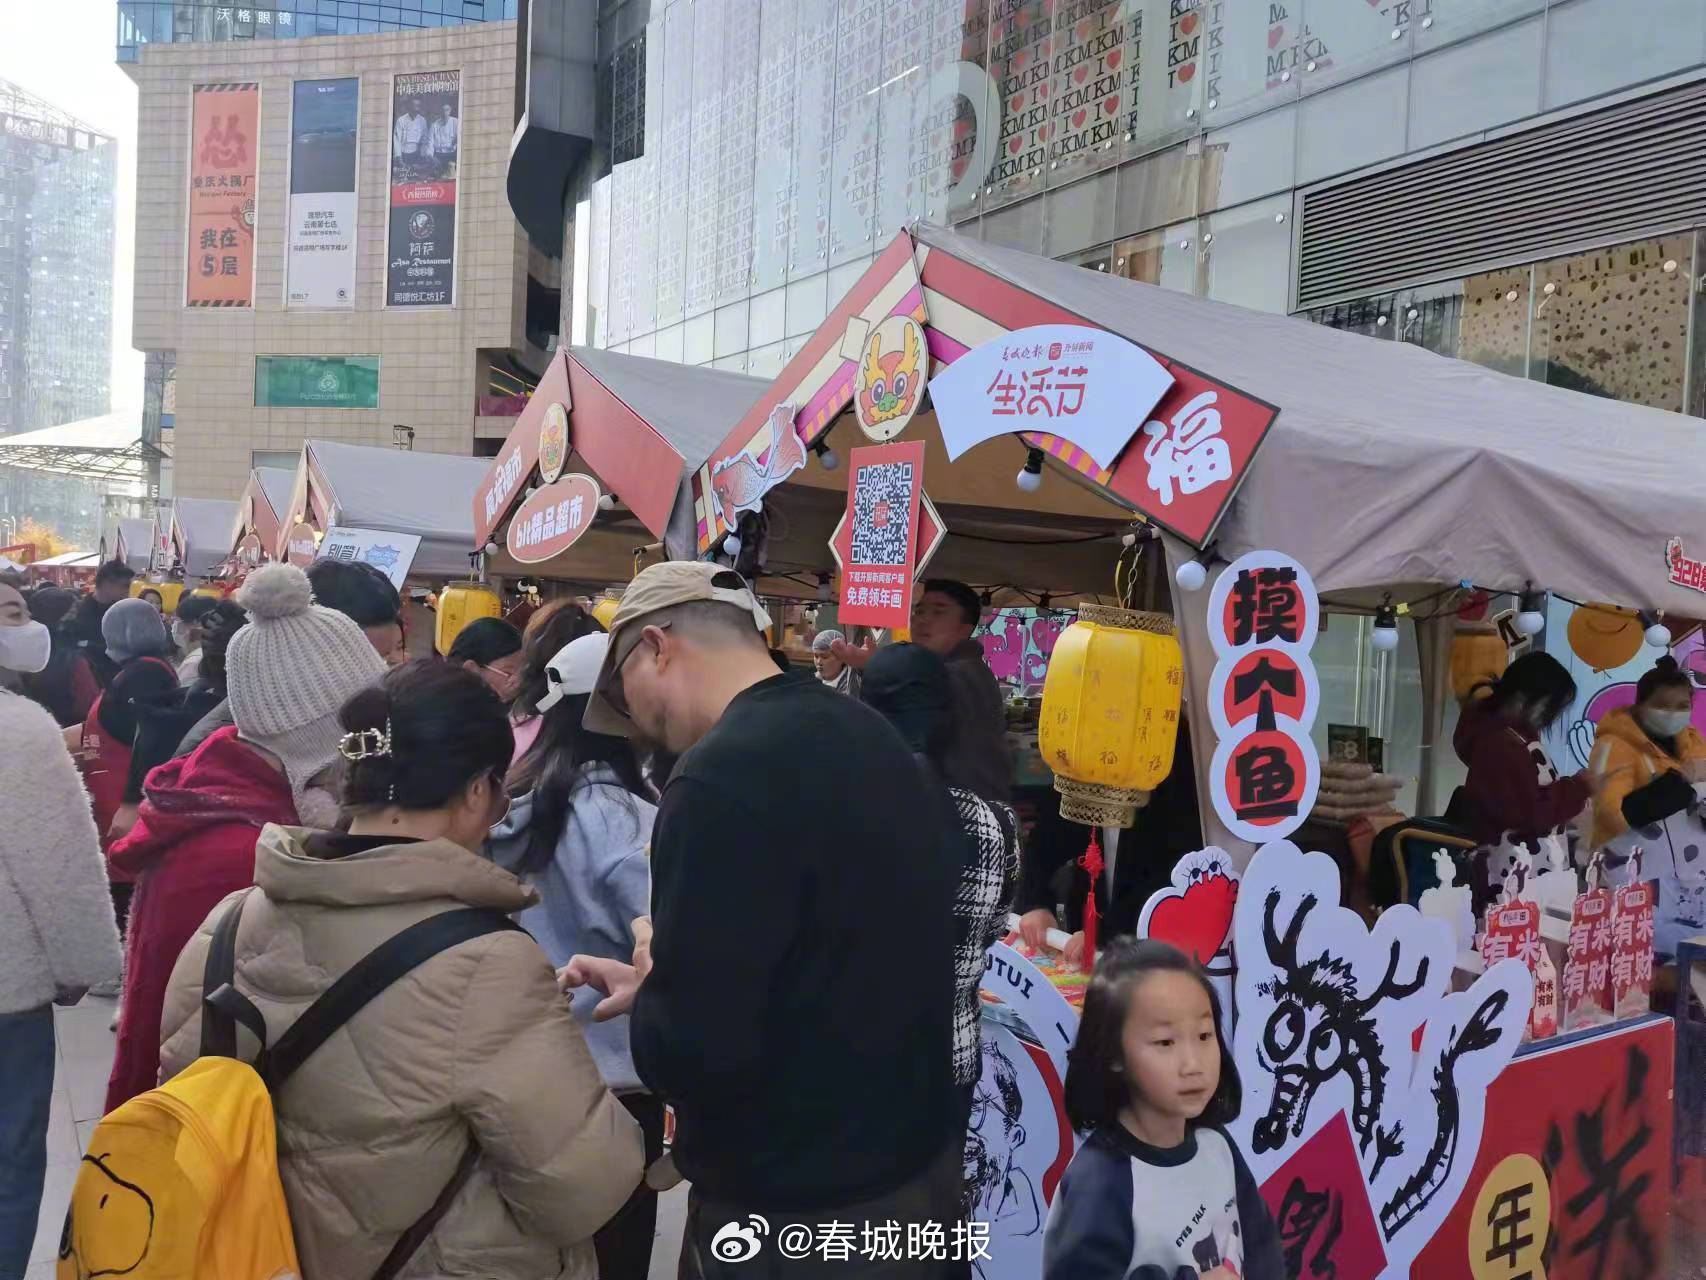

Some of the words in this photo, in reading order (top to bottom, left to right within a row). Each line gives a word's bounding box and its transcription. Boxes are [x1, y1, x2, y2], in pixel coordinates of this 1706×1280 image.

[216, 8, 293, 25] 沃格眼镜
[194, 175, 256, 187] 重庆火锅厂
[201, 228, 237, 249] 我在
[409, 241, 434, 256] 阿萨
[986, 365, 1089, 418] 生活节
[1144, 391, 1233, 506] 福
[846, 586, 904, 609] 免费领年画
[1568, 916, 1612, 957] 有米
[1613, 907, 1655, 949] 有米
[1563, 954, 1609, 999] 有财
[1612, 945, 1655, 989] 有财
[1175, 1225, 1193, 1248] EYES
[1191, 1203, 1208, 1226] TALK
[1485, 1182, 1534, 1269] 年
